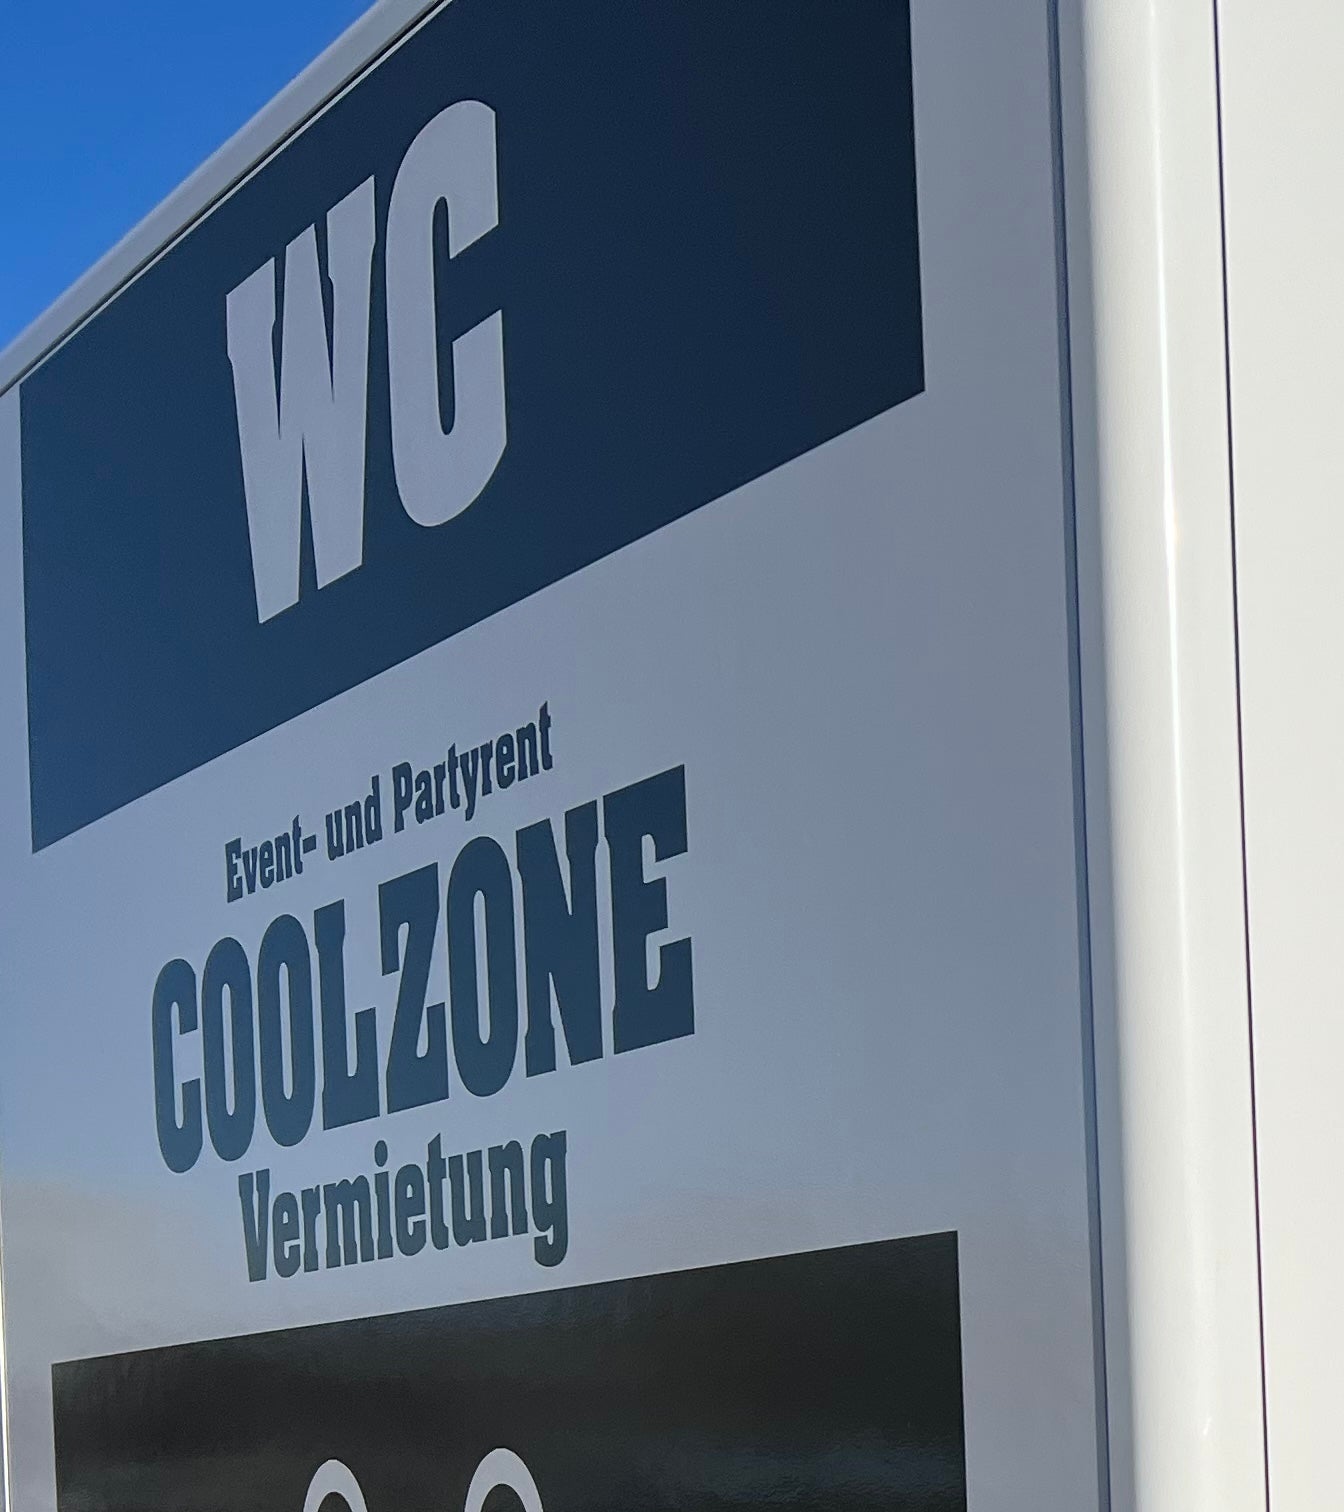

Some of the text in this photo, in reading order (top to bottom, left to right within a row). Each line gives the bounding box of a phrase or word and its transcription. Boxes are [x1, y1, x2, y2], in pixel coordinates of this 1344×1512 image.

[225, 99, 508, 624] WC
[224, 701, 553, 903] Event- und Partyrent
[152, 764, 694, 1173] COOLZONE
[238, 1129, 568, 1282] Vermietung
